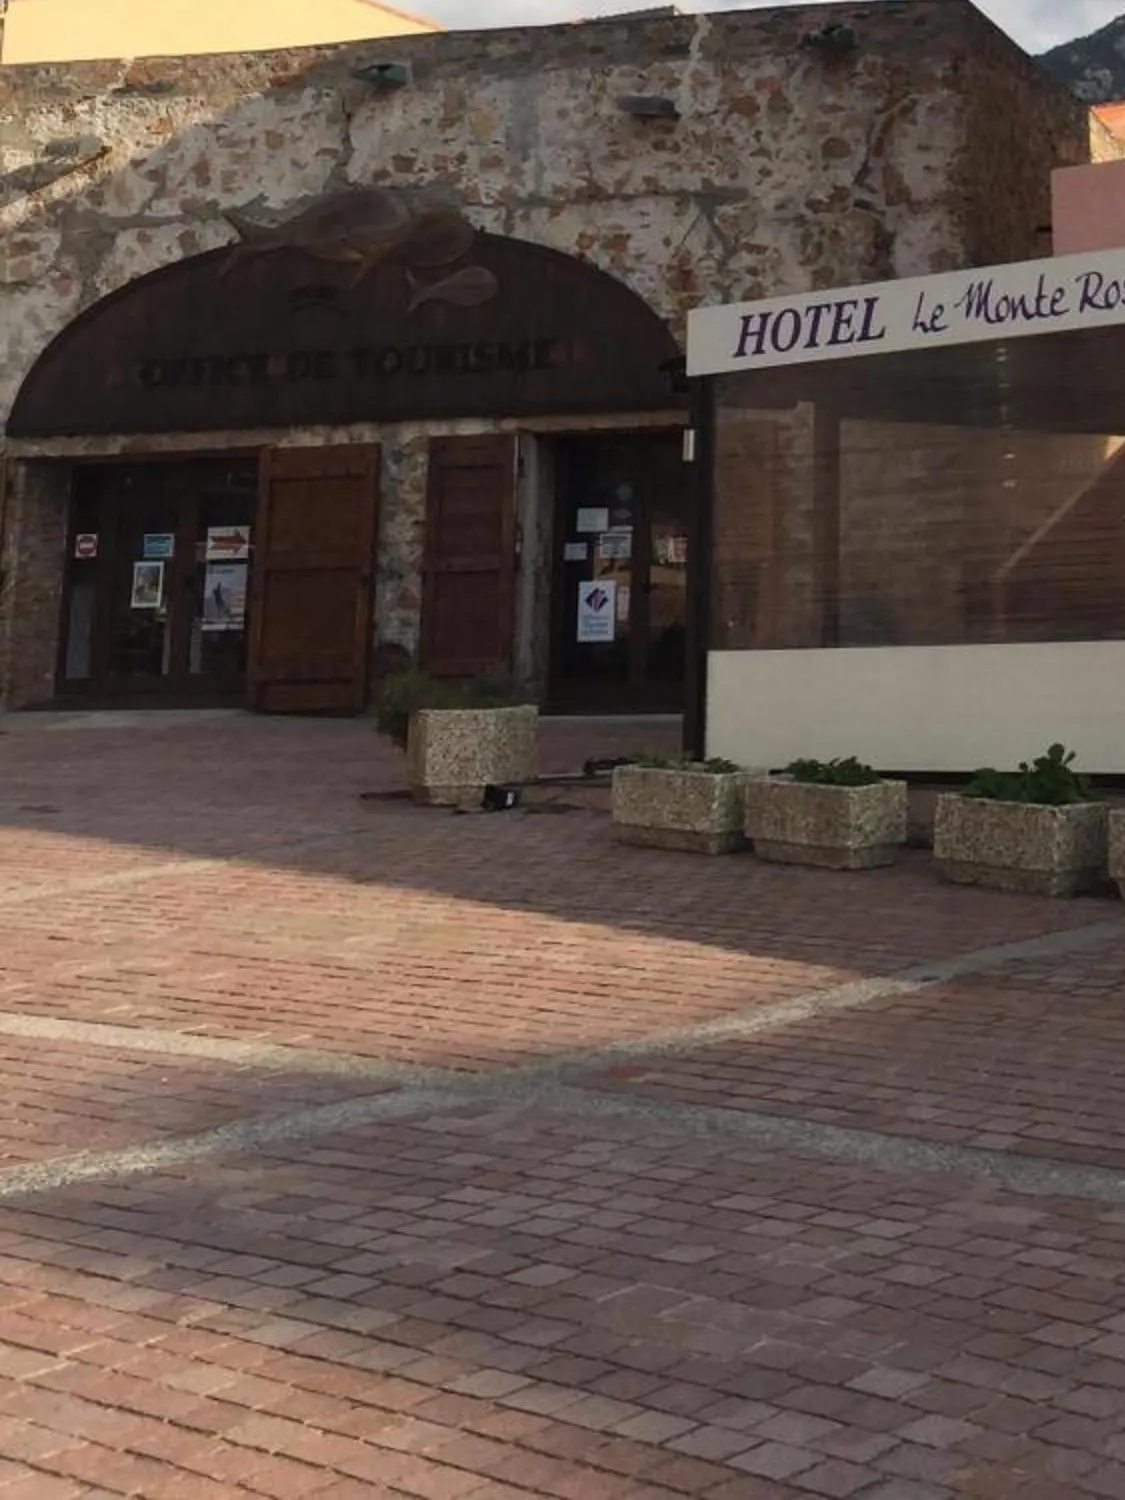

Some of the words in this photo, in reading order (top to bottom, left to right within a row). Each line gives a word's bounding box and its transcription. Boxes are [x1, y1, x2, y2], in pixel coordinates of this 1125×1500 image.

[734, 297, 886, 357] HOTEL
[911, 291, 949, 333] Le
[957, 273, 1067, 327] Monte
[287, 349, 336, 381] DE
[347, 335, 562, 379] TOURISME
